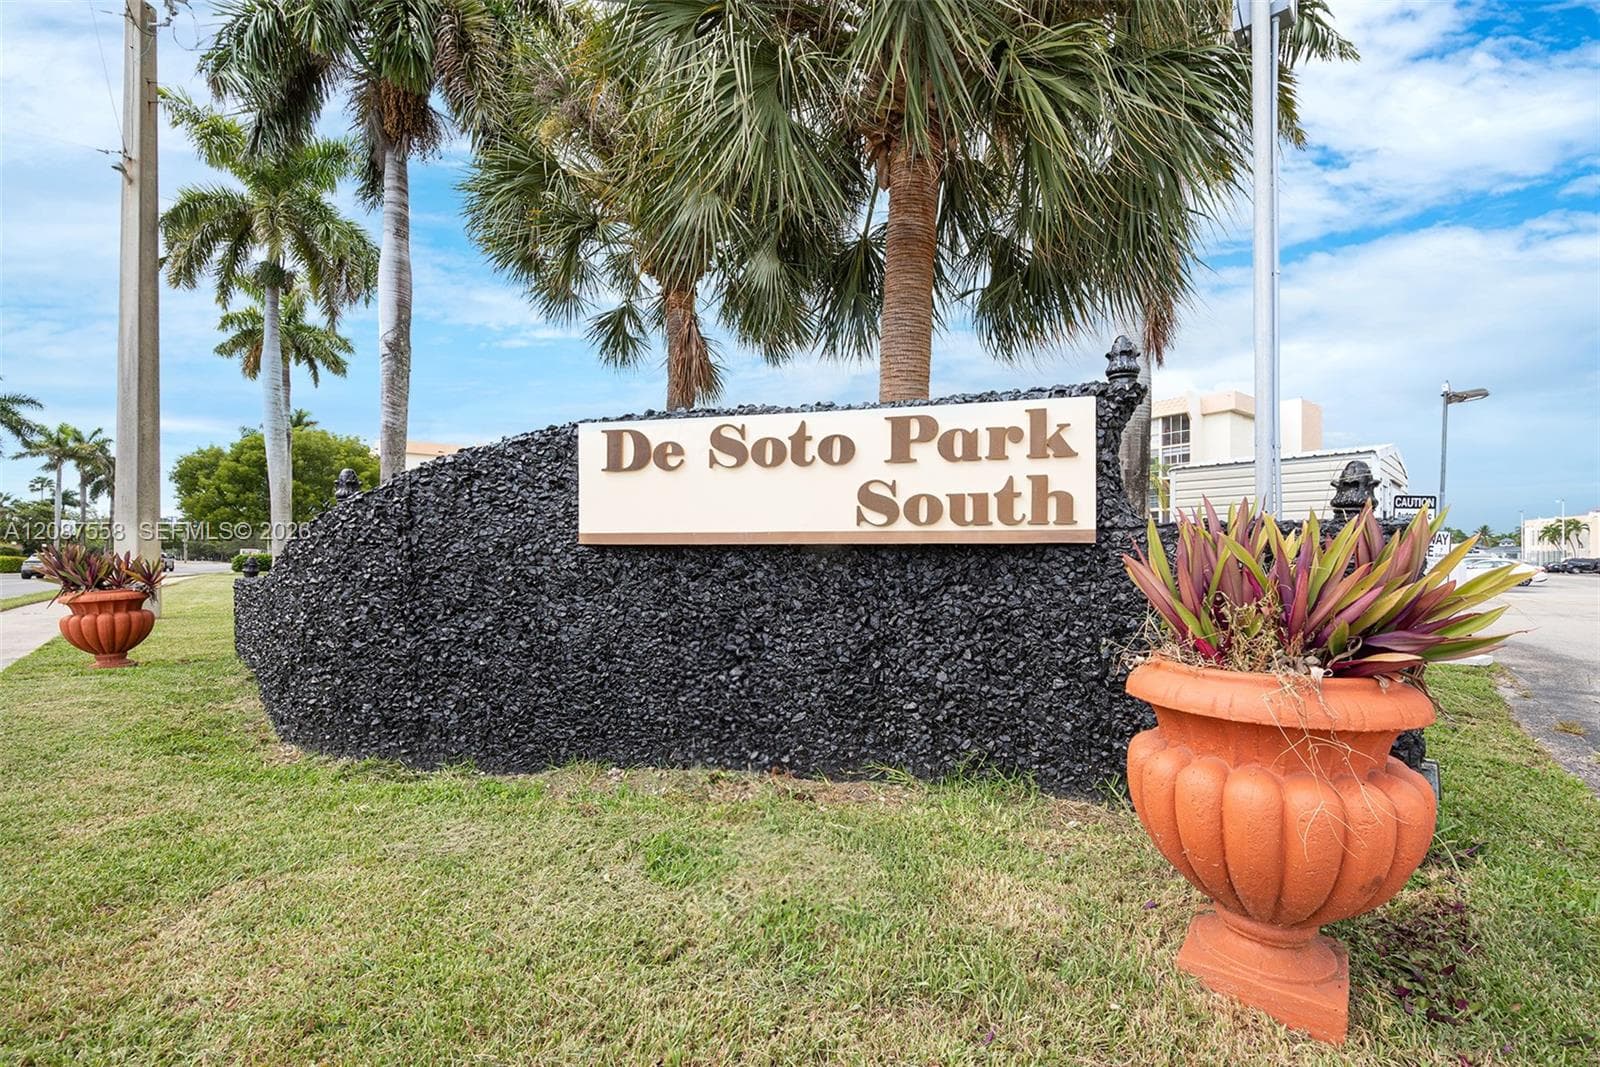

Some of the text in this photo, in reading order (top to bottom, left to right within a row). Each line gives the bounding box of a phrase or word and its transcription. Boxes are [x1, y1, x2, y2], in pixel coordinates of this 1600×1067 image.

[601, 408, 1078, 473] De Soto Park
[856, 475, 1077, 526] South
[1395, 497, 1434, 507] CAUTION
